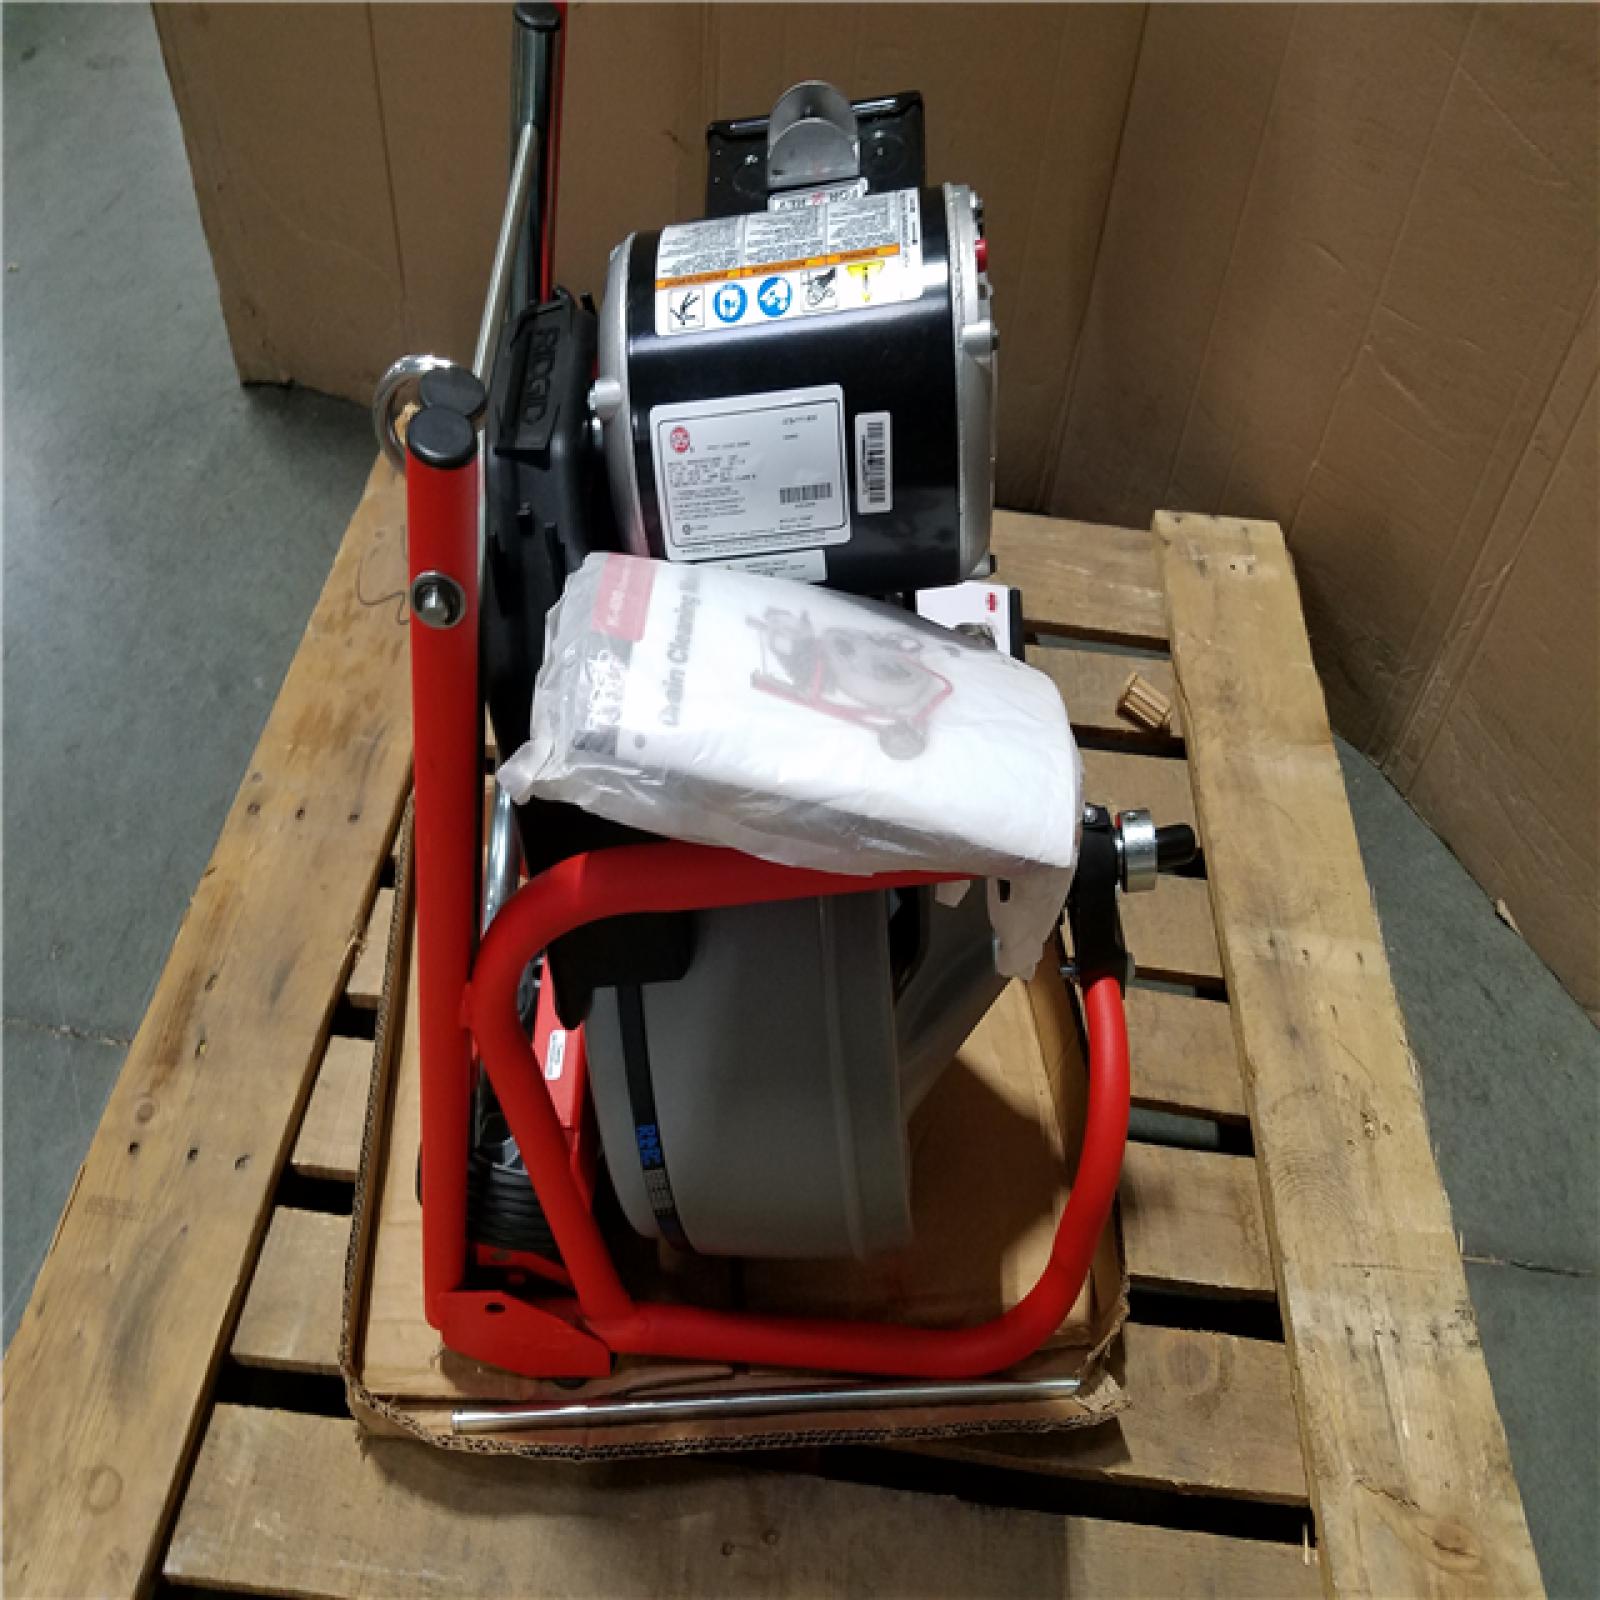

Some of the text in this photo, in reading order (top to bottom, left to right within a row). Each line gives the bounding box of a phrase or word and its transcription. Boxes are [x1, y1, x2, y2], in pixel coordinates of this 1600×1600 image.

[524, 328, 561, 426] RIDGID
[667, 594, 701, 664] Cleaning
[658, 668, 687, 728] Drain
